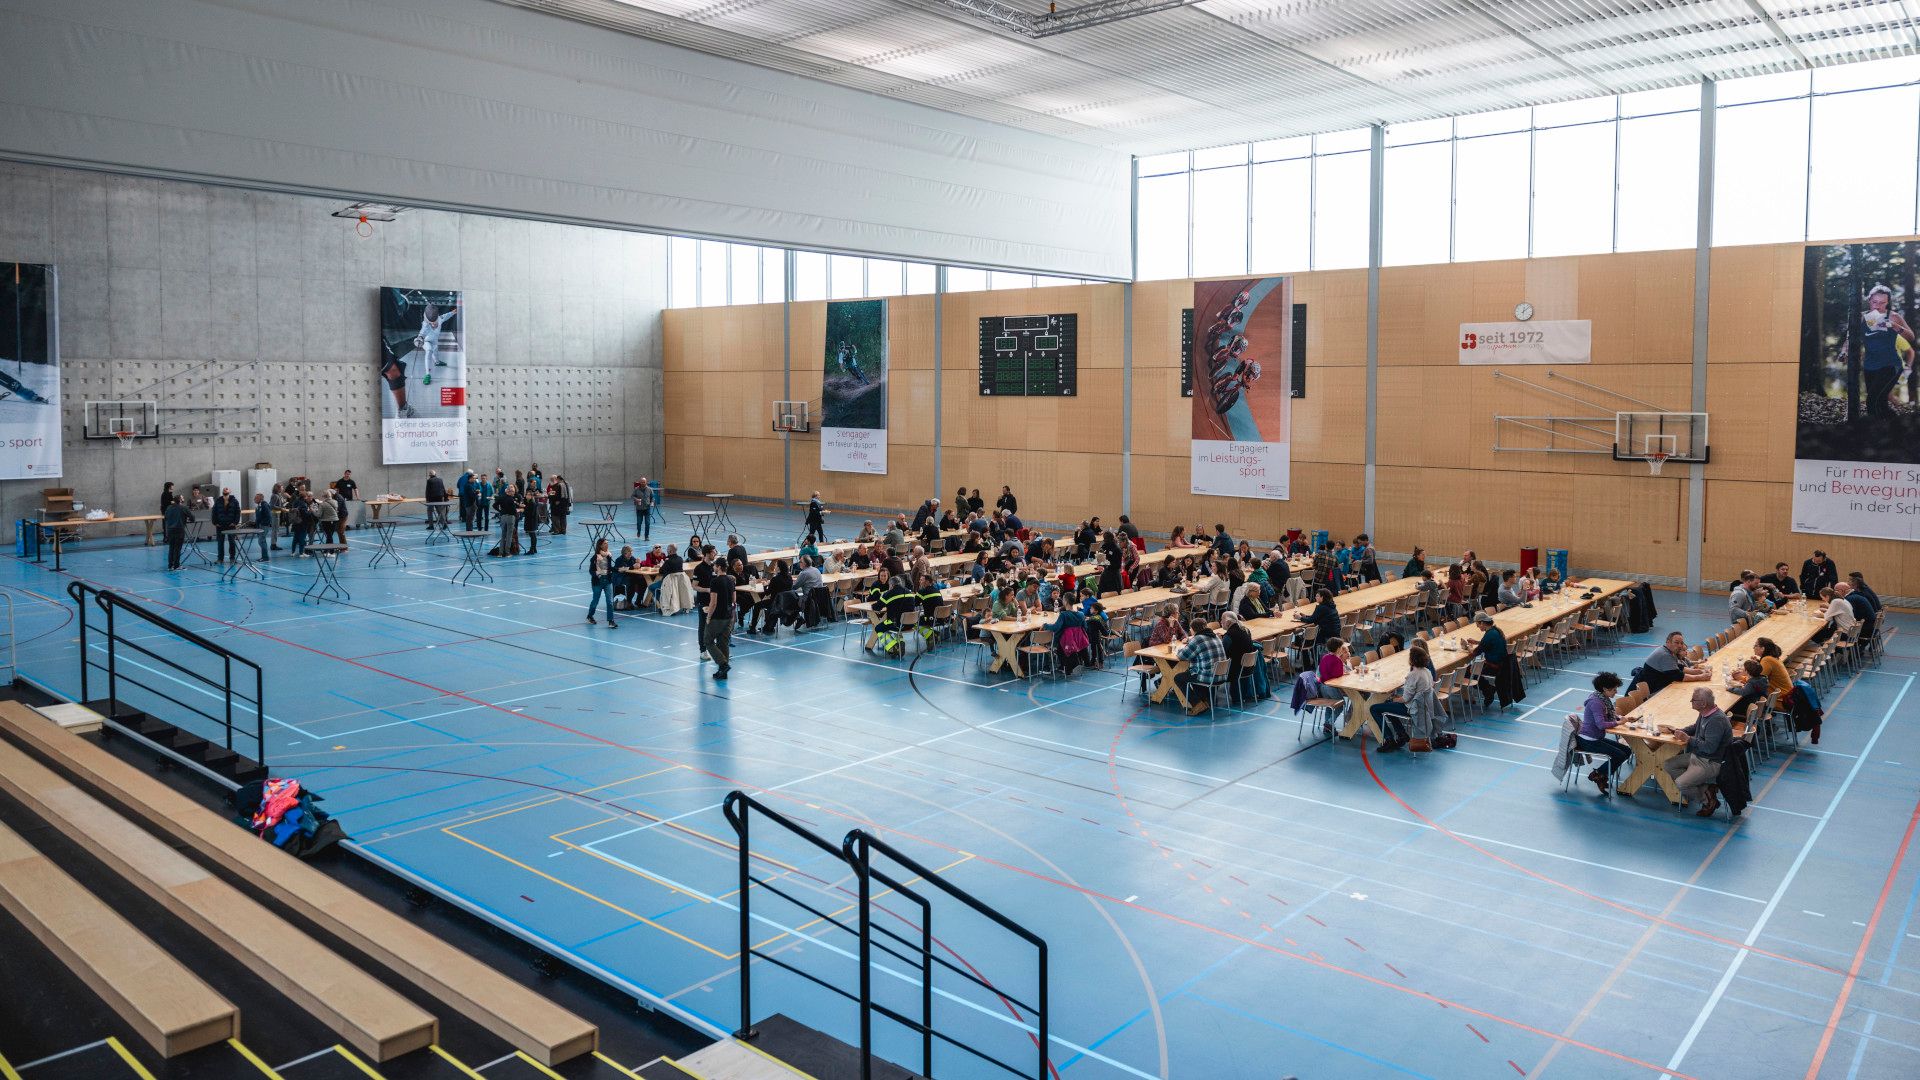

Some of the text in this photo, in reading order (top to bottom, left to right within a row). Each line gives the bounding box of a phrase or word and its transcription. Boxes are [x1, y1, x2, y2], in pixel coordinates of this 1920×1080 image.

[1478, 332, 1505, 345] seit
[1509, 331, 1544, 344] 1972
[384, 429, 438, 439] de formation
[9, 437, 43, 449] sport
[436, 438, 459, 449] sport
[1229, 443, 1269, 454] Engagiert
[1198, 452, 1262, 467] im Leistungs-
[1239, 467, 1265, 478] sport
[1825, 466, 1849, 478] Für
[1853, 465, 1902, 480] mehr
[1799, 480, 1920, 500] und Bewegun
[1850, 499, 1863, 511] in
[1867, 500, 1892, 513] der
